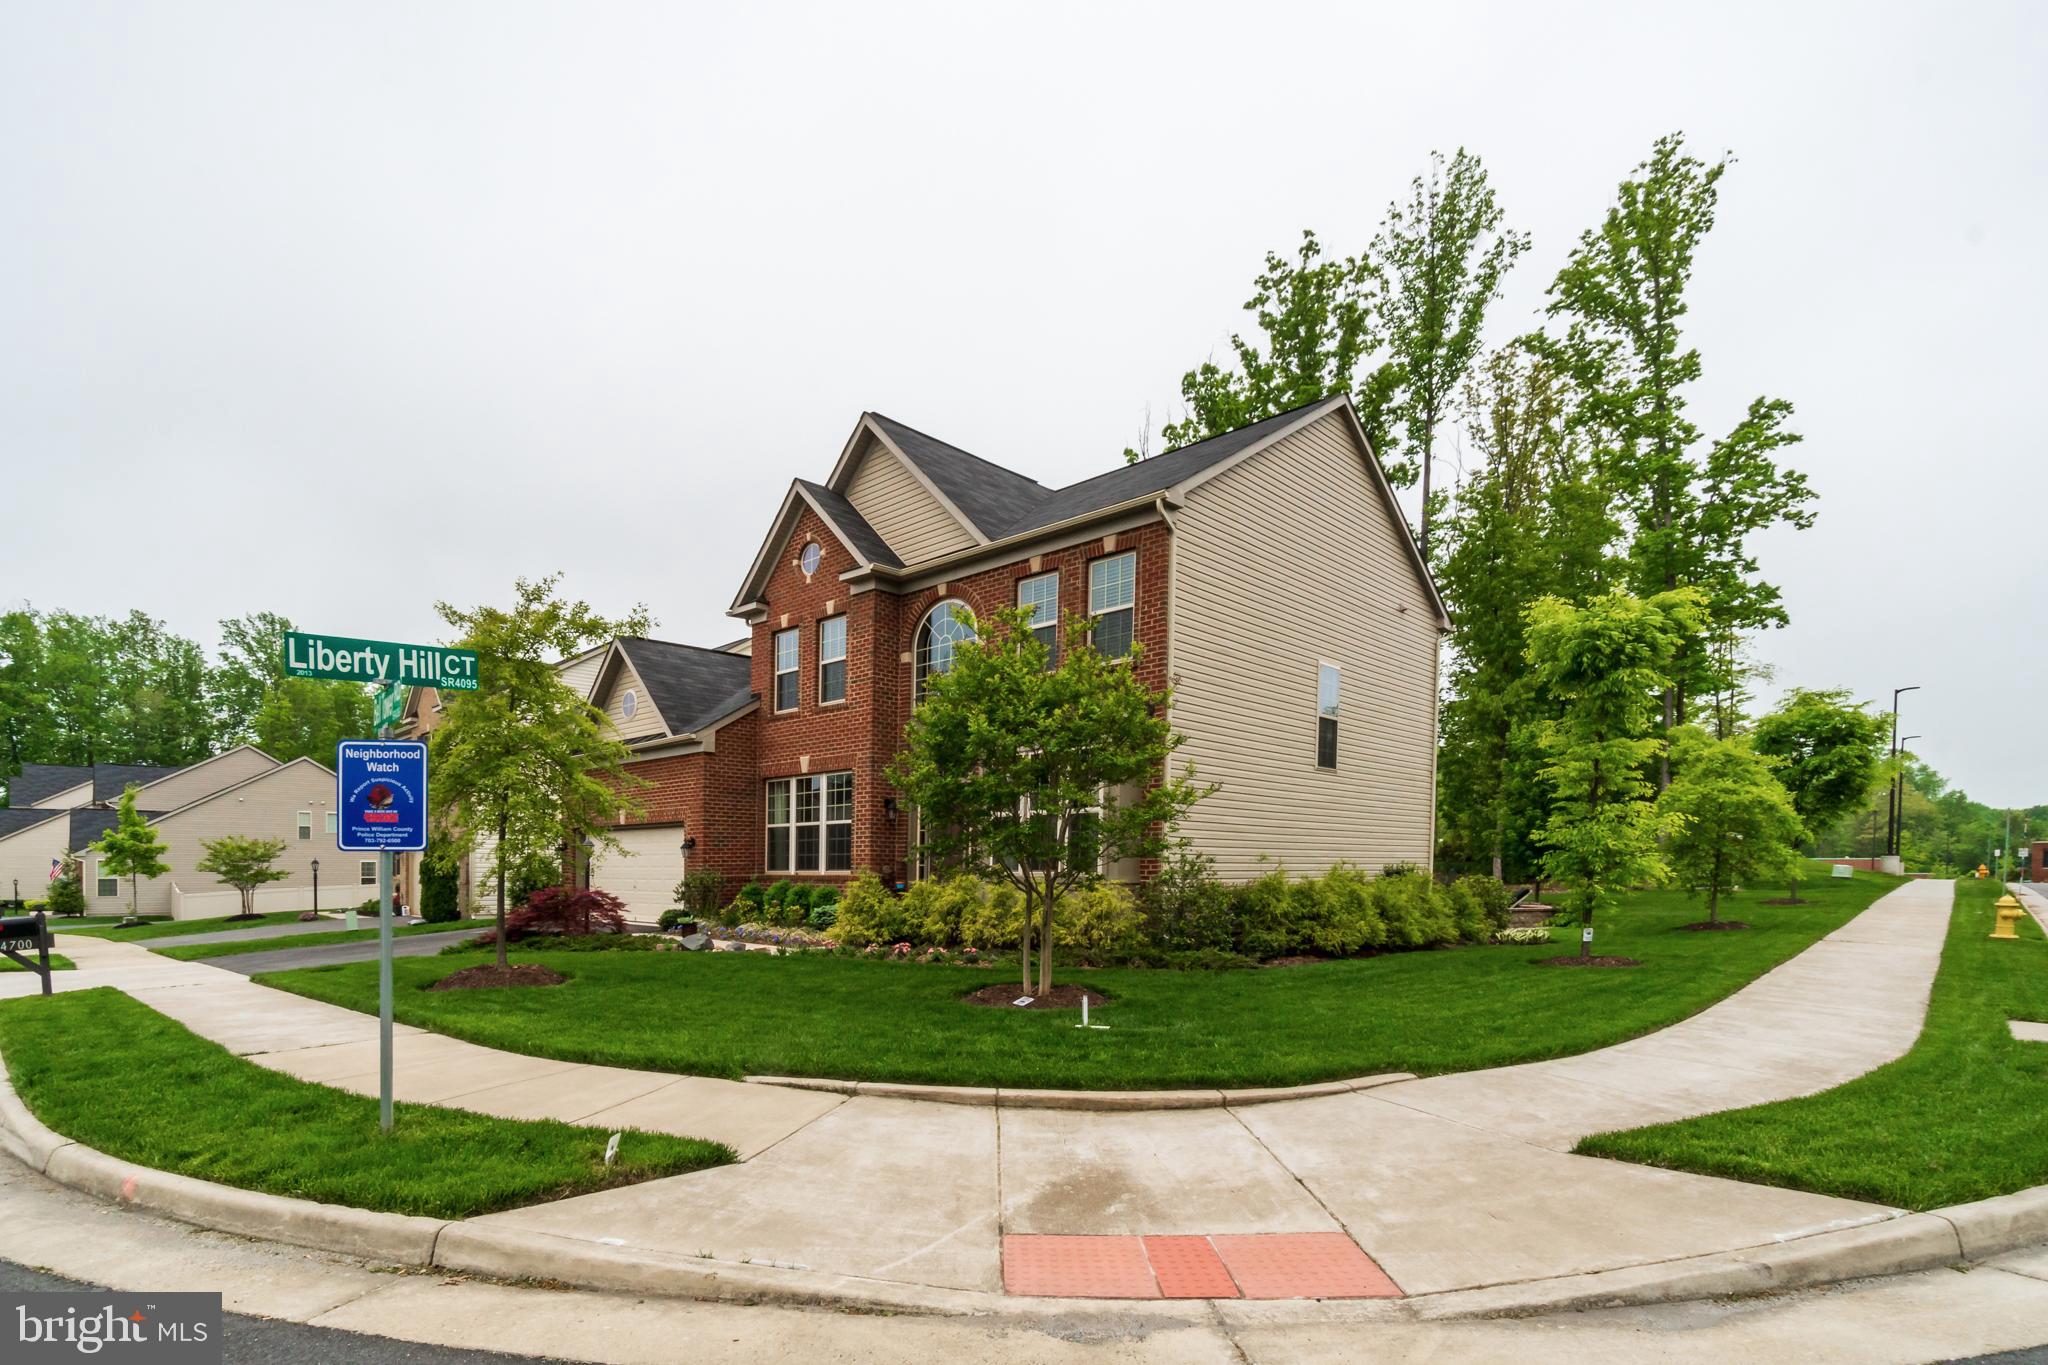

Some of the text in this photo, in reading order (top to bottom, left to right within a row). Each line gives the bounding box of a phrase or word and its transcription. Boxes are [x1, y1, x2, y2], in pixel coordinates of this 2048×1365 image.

[288, 637, 475, 680] Liberty Hill CT
[296, 669, 313, 677] 2013
[441, 677, 478, 690] SR4095
[345, 748, 421, 761] Neighborhood
[366, 762, 400, 772] Watch
[0, 939, 33, 951] 4700
